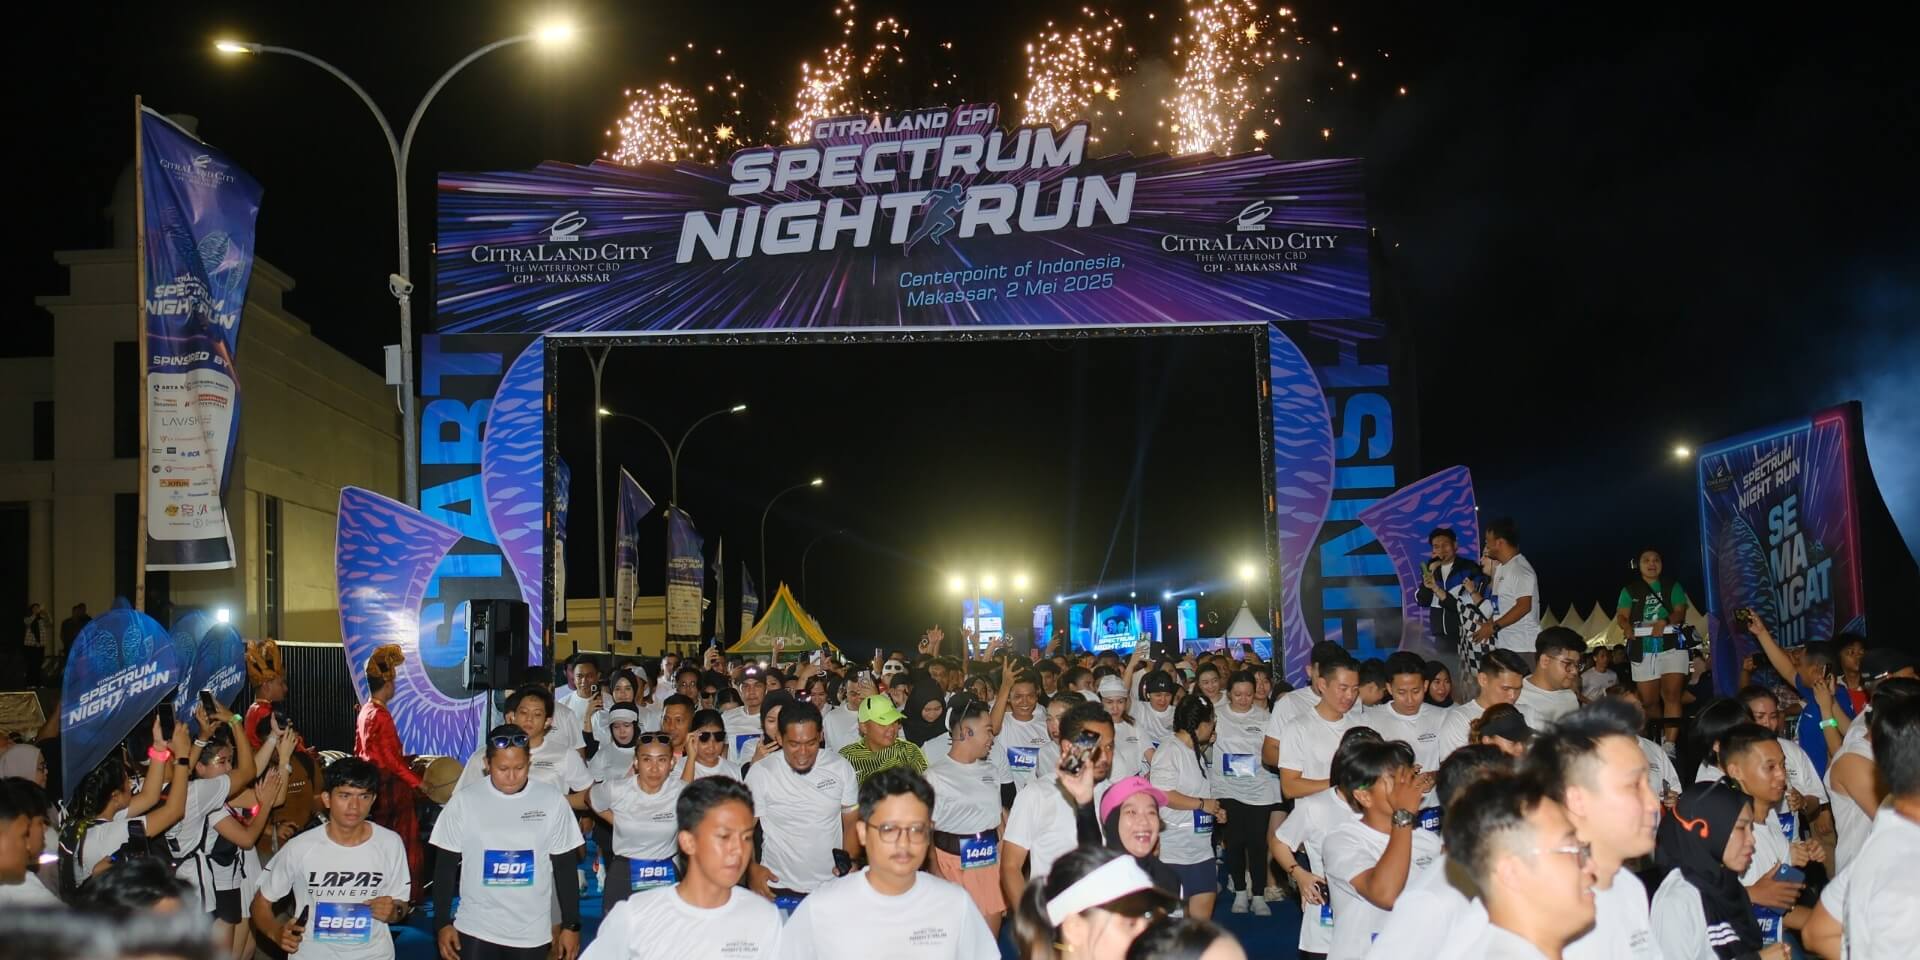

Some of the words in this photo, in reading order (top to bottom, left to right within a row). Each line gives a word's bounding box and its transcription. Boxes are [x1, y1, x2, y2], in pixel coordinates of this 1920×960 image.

[815, 112, 948, 139] CITRALAND
[957, 108, 994, 127] CPI
[729, 125, 1088, 196] SPECTRUM
[676, 190, 926, 263] NIGHT
[959, 172, 1136, 239] RUN
[597, 262, 620, 271] CBD
[1203, 264, 1223, 273] CPI
[1234, 263, 1298, 272] MAKASSAR
[1284, 251, 1307, 260] CBD
[513, 275, 533, 284] CPI
[546, 273, 610, 283] MAKASSAR
[900, 264, 1007, 288] Centerpoint
[1014, 261, 1032, 277] of
[1037, 253, 1125, 274] Indonesia,
[907, 288, 998, 307] Makassar,
[1006, 282, 1019, 298] 2
[1025, 278, 1058, 296] Mei
[1063, 273, 1114, 292] 2025
[199, 304, 236, 329] RUN
[1743, 446, 1792, 489] SPECTRUM
[1739, 477, 1771, 511] NIGHT
[1776, 457, 1800, 488] RUN
[1768, 494, 1798, 545] SE
[1770, 532, 1808, 583] MA
[755, 633, 806, 646] Gab
[80, 661, 157, 705] SPECTRUM
[69, 689, 125, 725] NIGHT
[129, 670, 170, 697] RUN
[308, 871, 384, 888] LAPAS
[493, 862, 527, 874] 1901
[640, 866, 668, 878] 1981
[308, 889, 378, 897] RUNNERS
[318, 916, 367, 929] 2860
